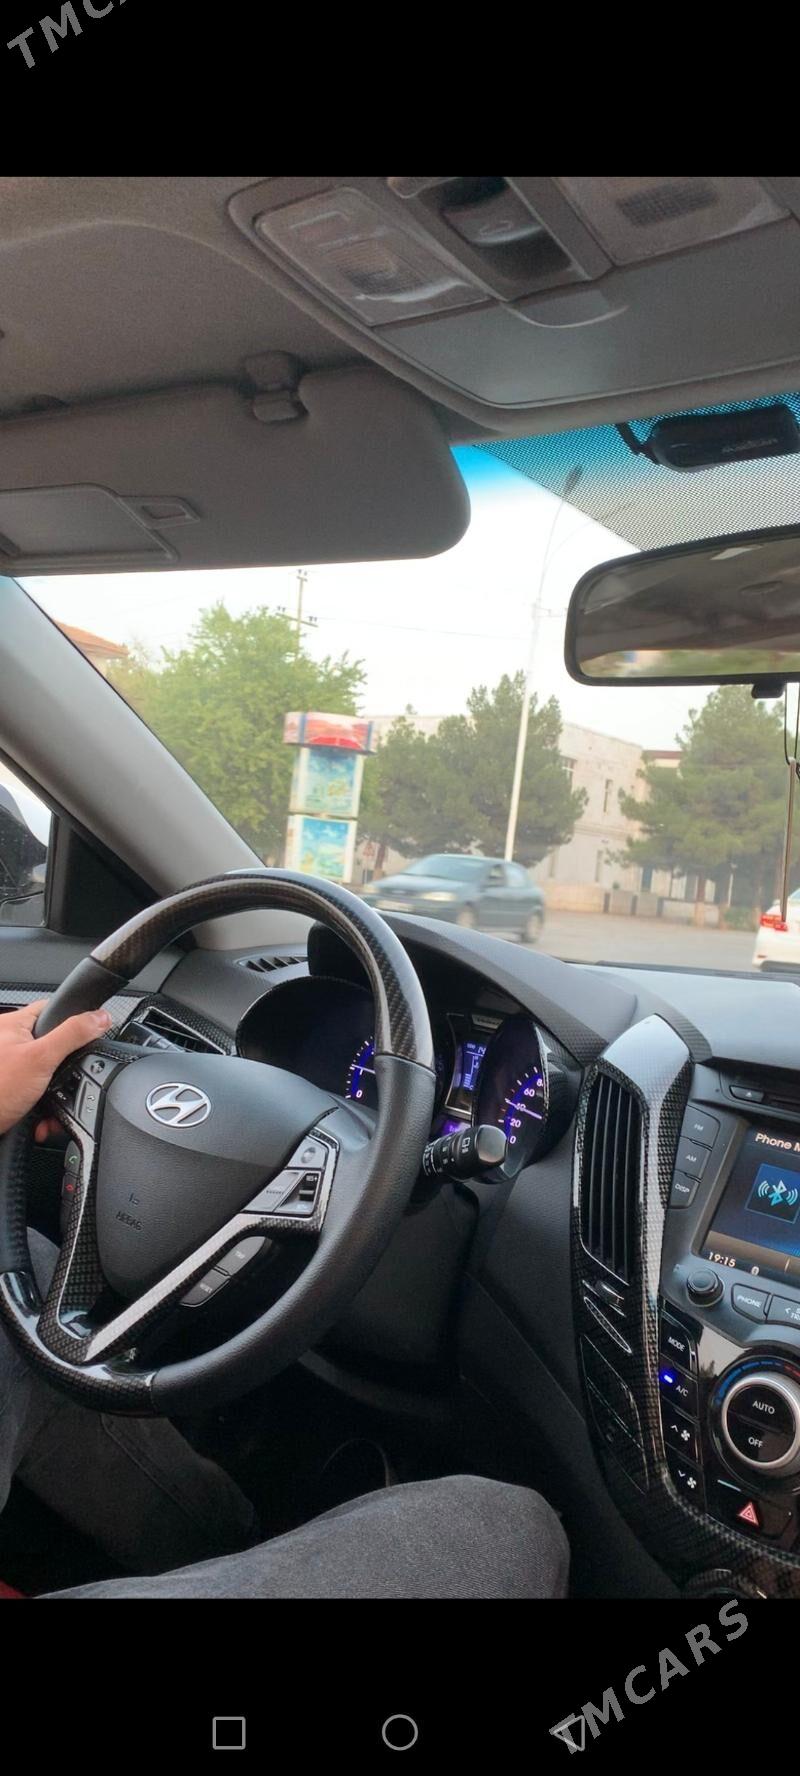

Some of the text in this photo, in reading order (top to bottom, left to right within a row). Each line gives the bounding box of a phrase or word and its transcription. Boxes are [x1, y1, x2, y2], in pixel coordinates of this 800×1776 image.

[355, 1089, 363, 1099] 0
[523, 1087, 536, 1098] 60
[510, 1117, 522, 1128] 20
[509, 1135, 517, 1145] 0
[754, 1132, 793, 1150] Phone
[708, 1251, 737, 1268] 19:15
[667, 1336, 686, 1352] MODE
[675, 1385, 689, 1397] A/C
[752, 1400, 776, 1415] AUTO
[747, 1436, 764, 1449] OFF
